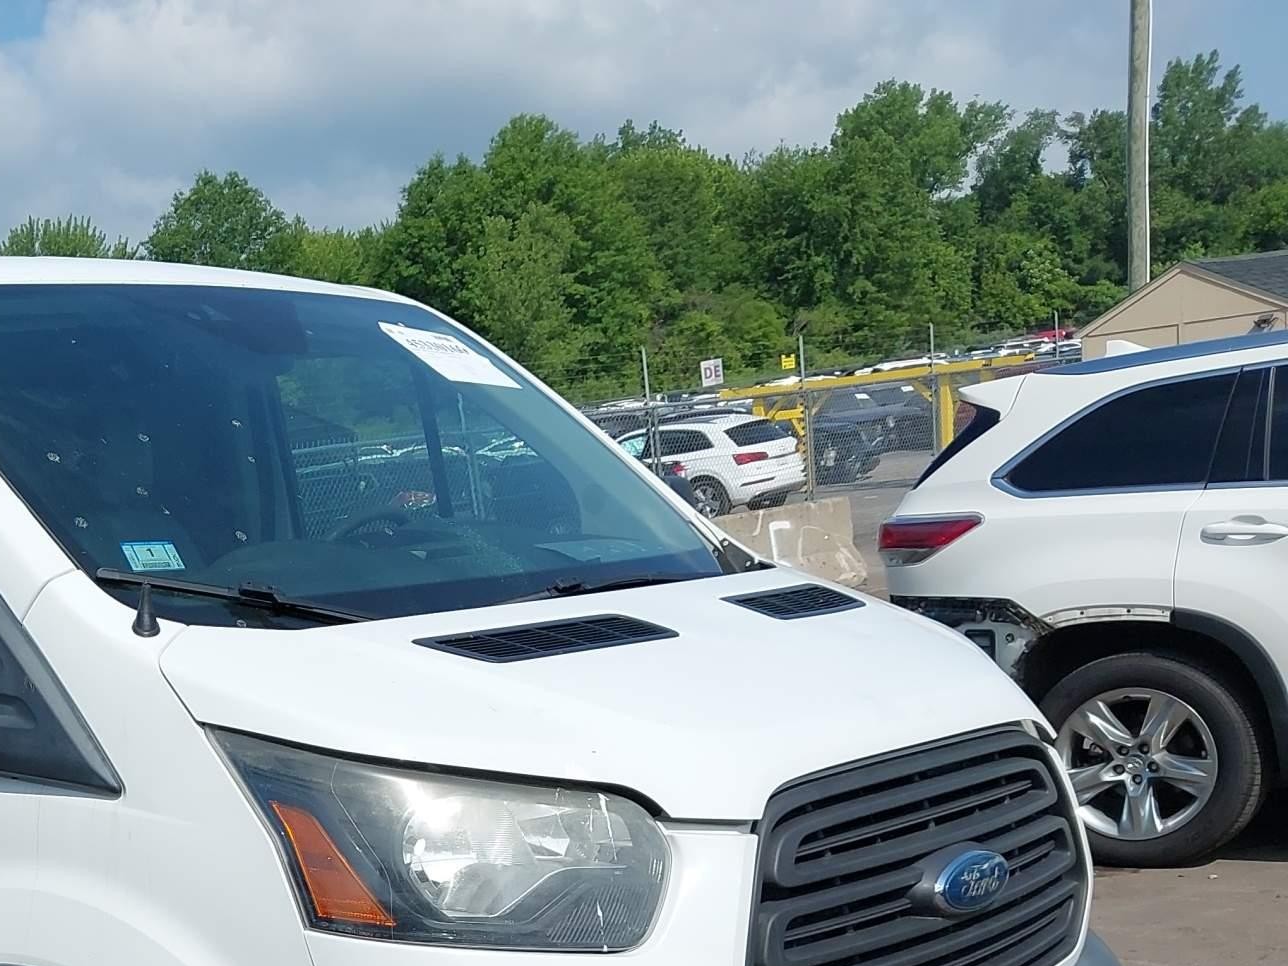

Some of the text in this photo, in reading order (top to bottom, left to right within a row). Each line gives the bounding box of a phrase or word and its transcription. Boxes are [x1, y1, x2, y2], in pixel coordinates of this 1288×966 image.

[704, 365, 721, 379] DE
[145, 548, 154, 557] 1
[960, 863, 1000, 898] Ford
